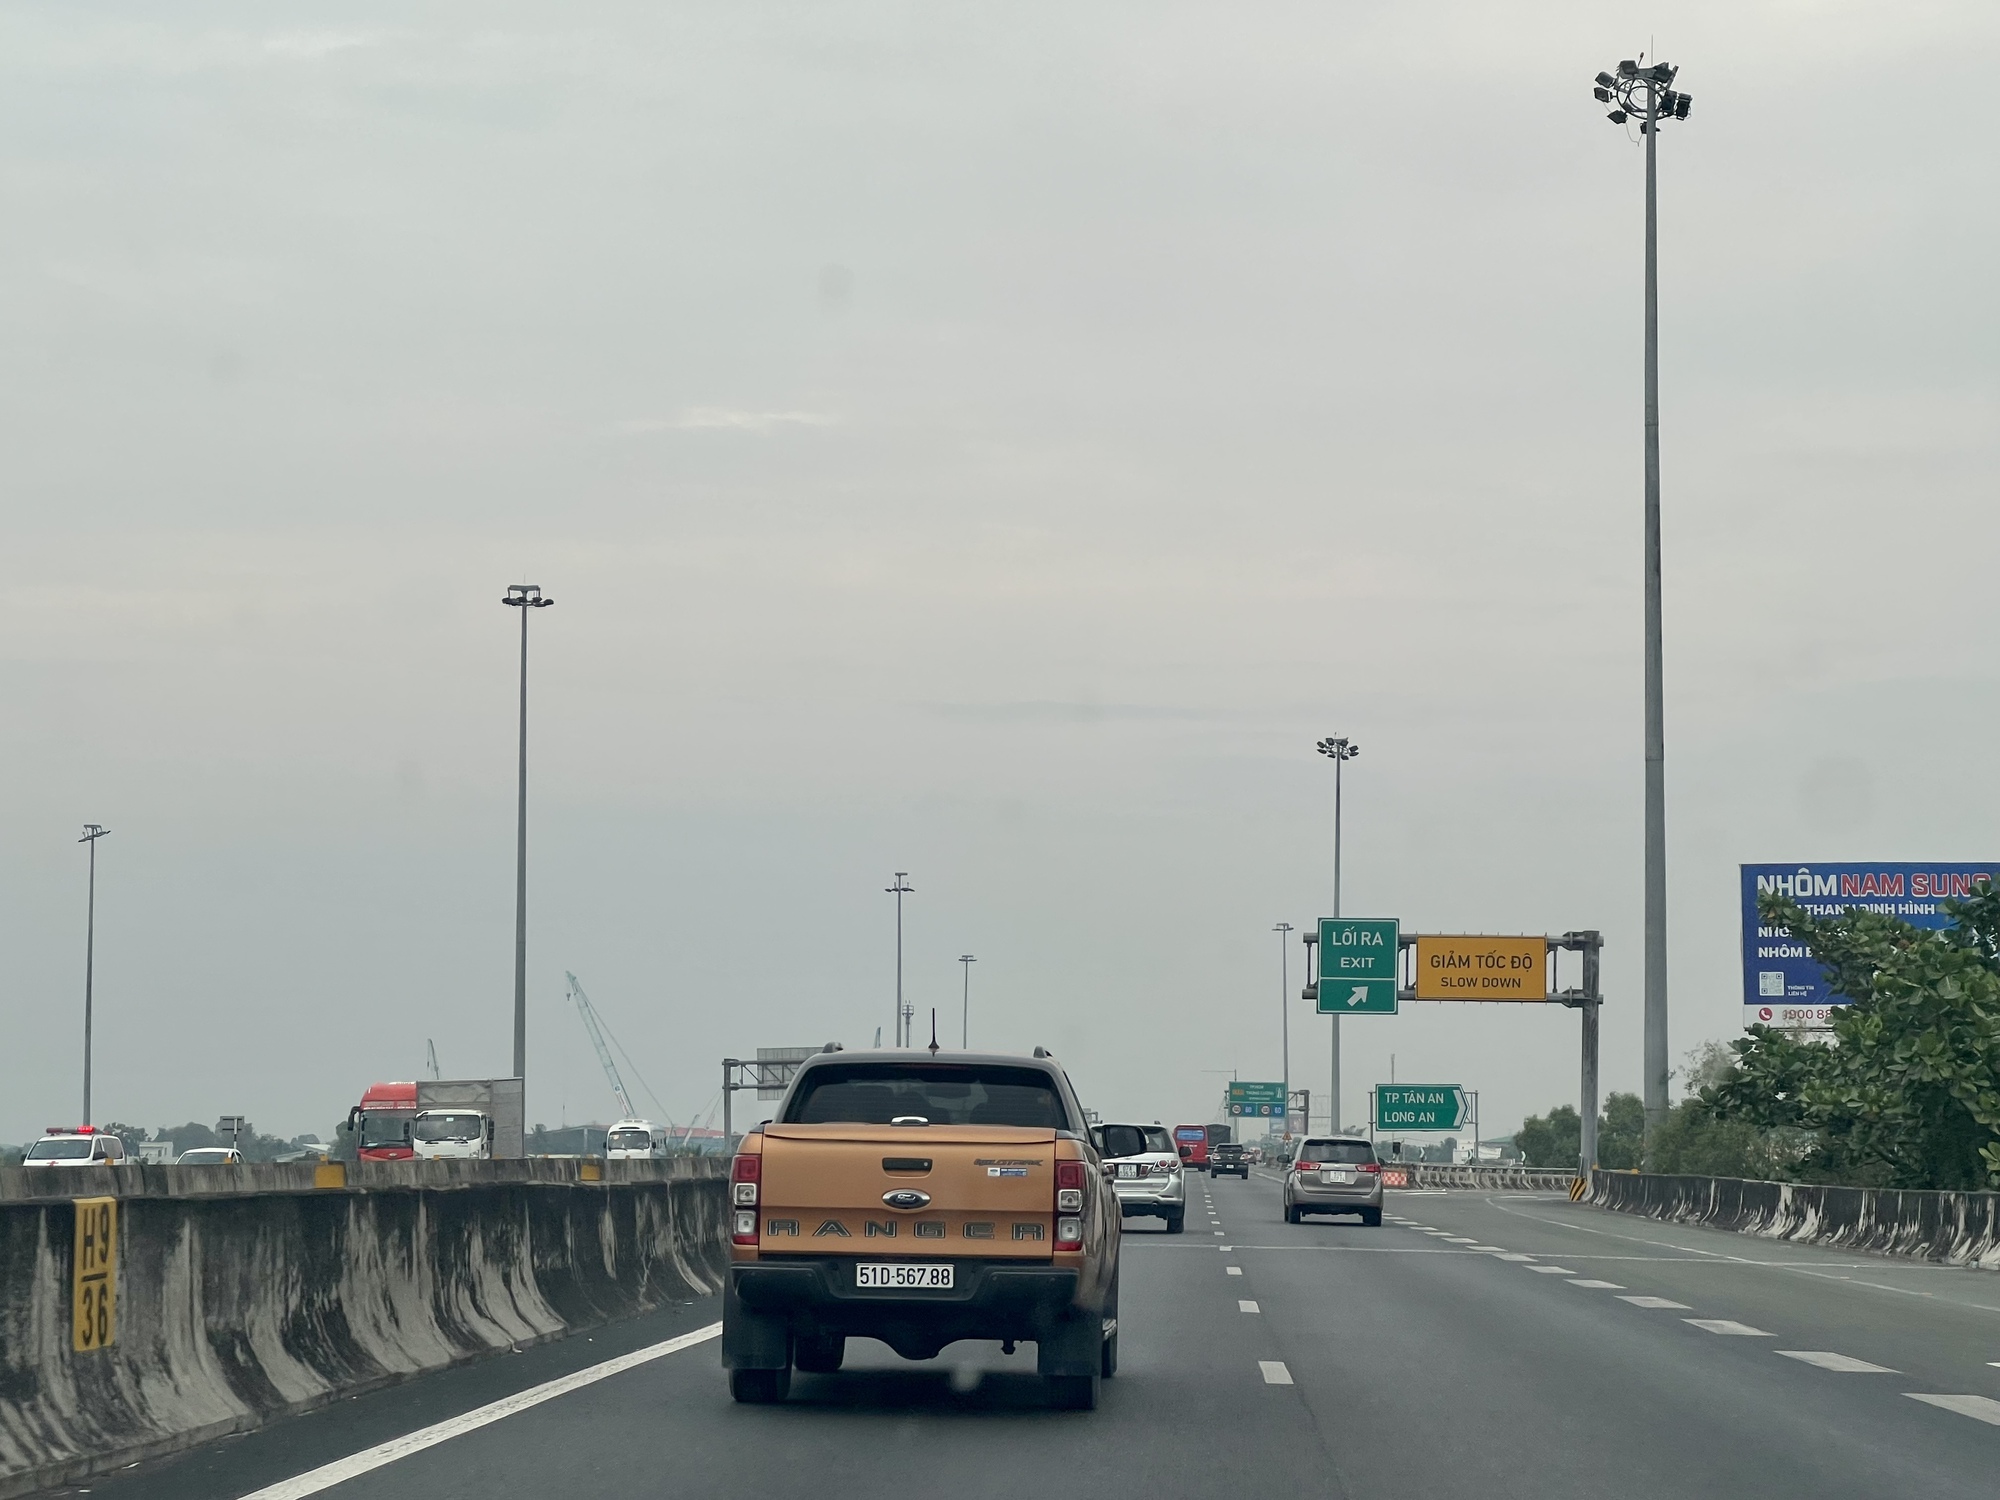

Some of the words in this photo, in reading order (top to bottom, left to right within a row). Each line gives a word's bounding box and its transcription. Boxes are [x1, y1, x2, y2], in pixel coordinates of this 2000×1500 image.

[1757, 867, 1837, 896] NHÔM
[1841, 873, 1904, 897] NAM
[1898, 900, 1935, 914] HÌNH
[1332, 925, 1357, 946] LỐI
[1361, 931, 1384, 946] RA
[1758, 943, 1803, 957] NHÔM
[1340, 957, 1375, 968] EXIT
[1430, 950, 1470, 968] GIẢM
[1475, 949, 1506, 969] TỐC
[1511, 952, 1533, 972] ĐỘ
[1440, 976, 1478, 987] SLOW
[1482, 977, 1521, 988] DOWN
[1385, 1092, 1399, 1104] TP.
[1402, 1090, 1425, 1104] TÂN
[1427, 1093, 1444, 1104] AN
[1384, 1111, 1415, 1123] LONG
[1418, 1112, 1435, 1123] AN
[83, 1203, 110, 1270] H9
[767, 1218, 1045, 1241] RANGER
[860, 1267, 951, 1286] 51D-567.88
[82, 1283, 108, 1346] 36
